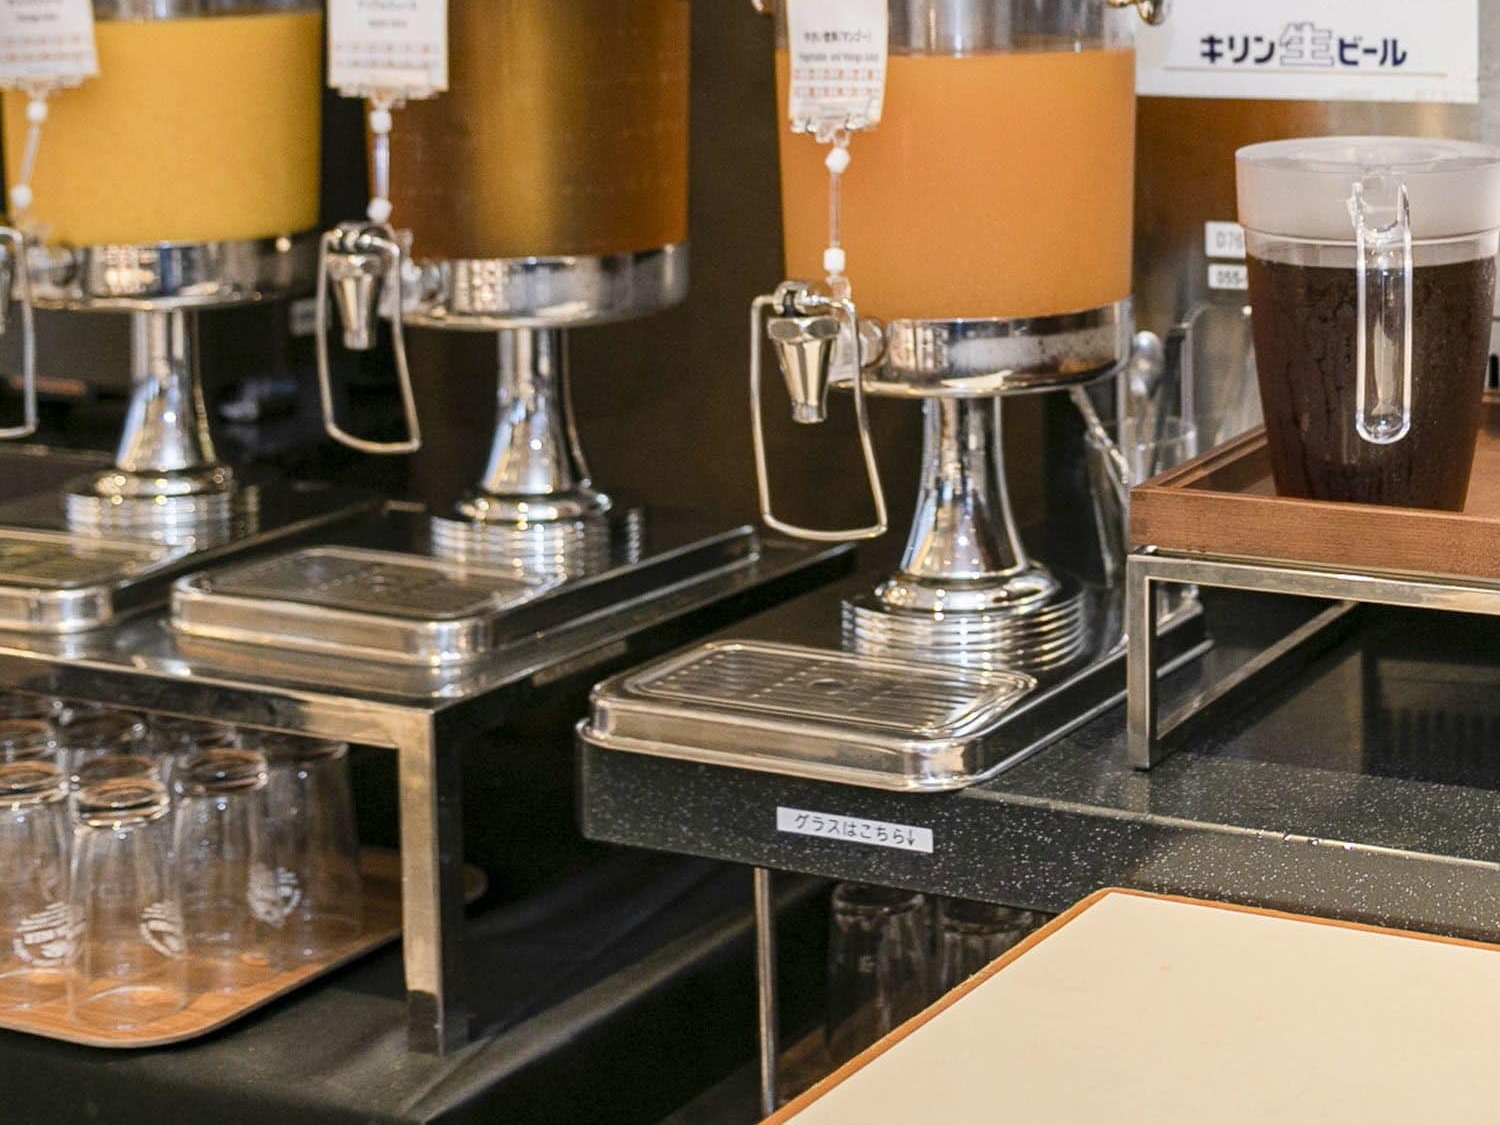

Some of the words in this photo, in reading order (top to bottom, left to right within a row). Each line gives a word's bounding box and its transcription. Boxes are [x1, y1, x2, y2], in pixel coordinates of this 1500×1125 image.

[1201, 22, 1408, 68] キリン生ビール
[795, 813, 905, 845] グラスはこちら
